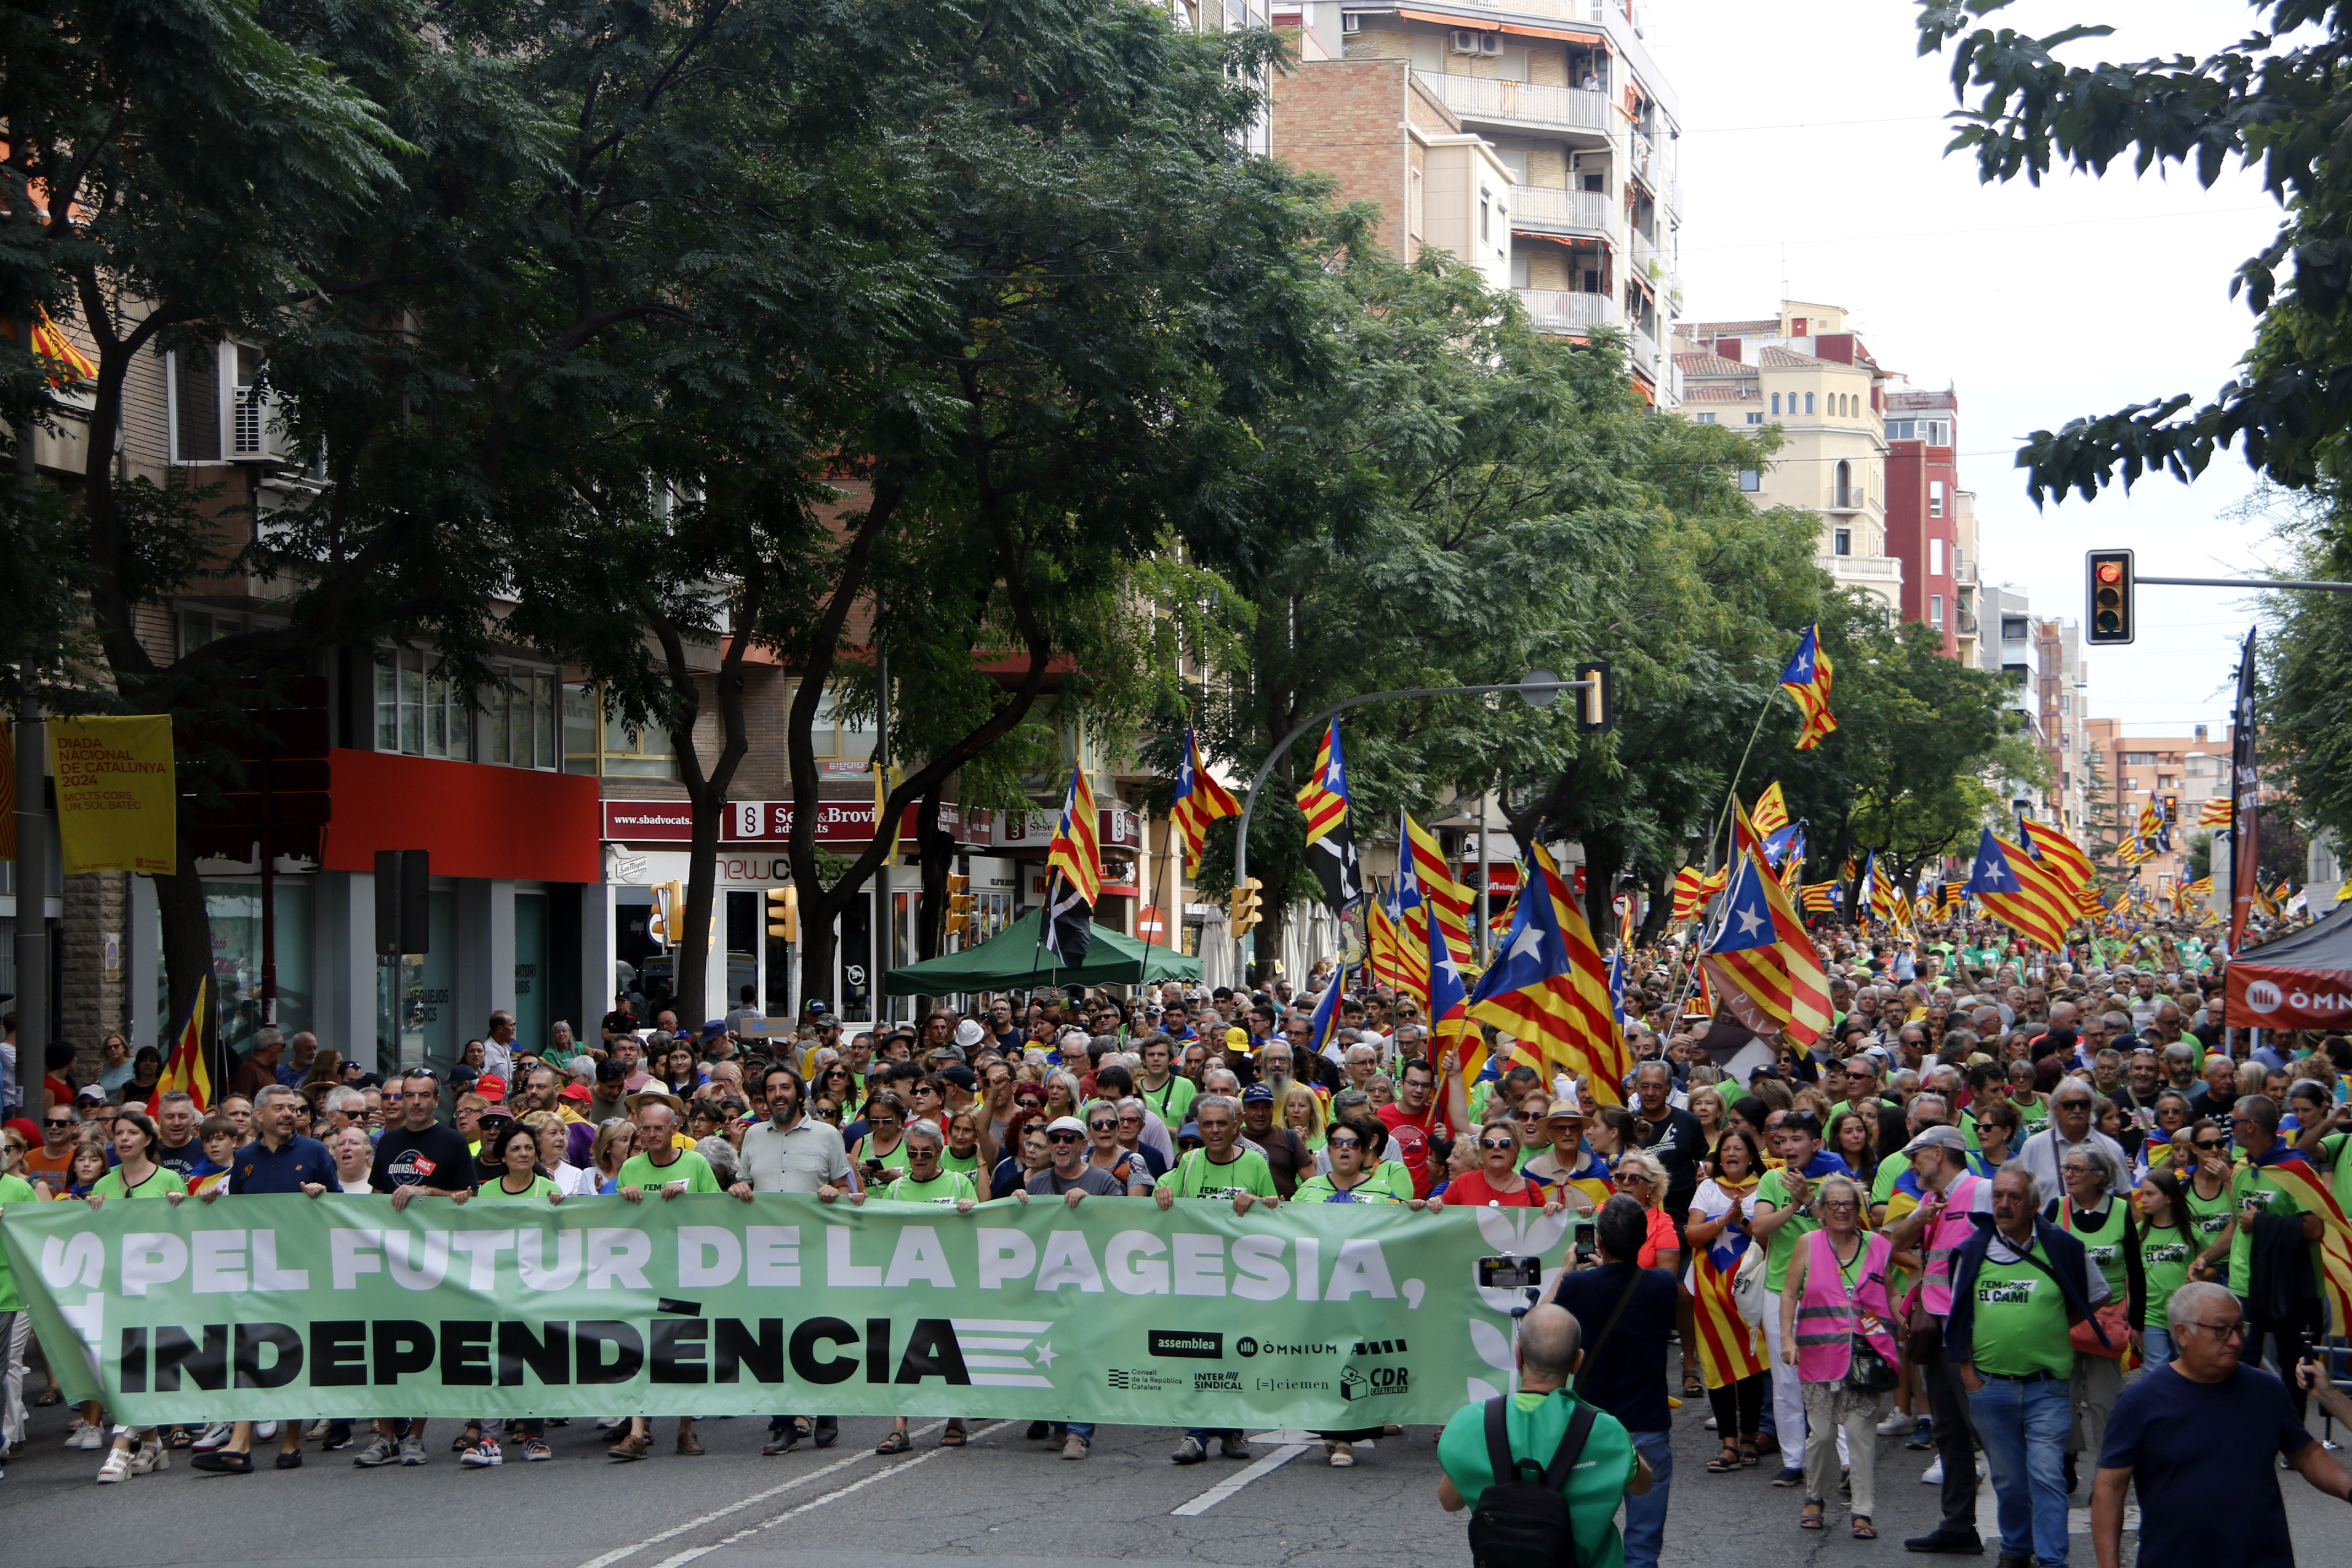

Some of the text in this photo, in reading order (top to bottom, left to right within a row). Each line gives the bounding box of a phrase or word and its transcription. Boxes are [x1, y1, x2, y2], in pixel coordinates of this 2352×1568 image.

[57, 738, 103, 749] DIADA
[59, 750, 134, 761] NACIONAL
[61, 762, 166, 775] DE CATALUNYA
[62, 775, 98, 787] 2024
[64, 791, 135, 802] MOLTS CORS,
[65, 801, 141, 812] UN SOL BATEC
[72, 861, 123, 871] diada.gencat.cat
[162, 1158, 183, 1167] TAILOR
[388, 1163, 429, 1177] QUIKSIL
[121, 1226, 1425, 1309] PEL FUTUR DE LA PAGESIA,
[1978, 1289, 1990, 1302] EL
[121, 1297, 971, 1393] INDEPENDÈNCIA
[1158, 1337, 1215, 1350] assemblea
[1263, 1341, 1337, 1355] ÒMNIUM
[1194, 1373, 1224, 1381] INTER
[1370, 1367, 1408, 1387] CDR
[1194, 1381, 1243, 1390] SINDICAL
[1371, 1386, 1408, 1395] CATALUNYA
